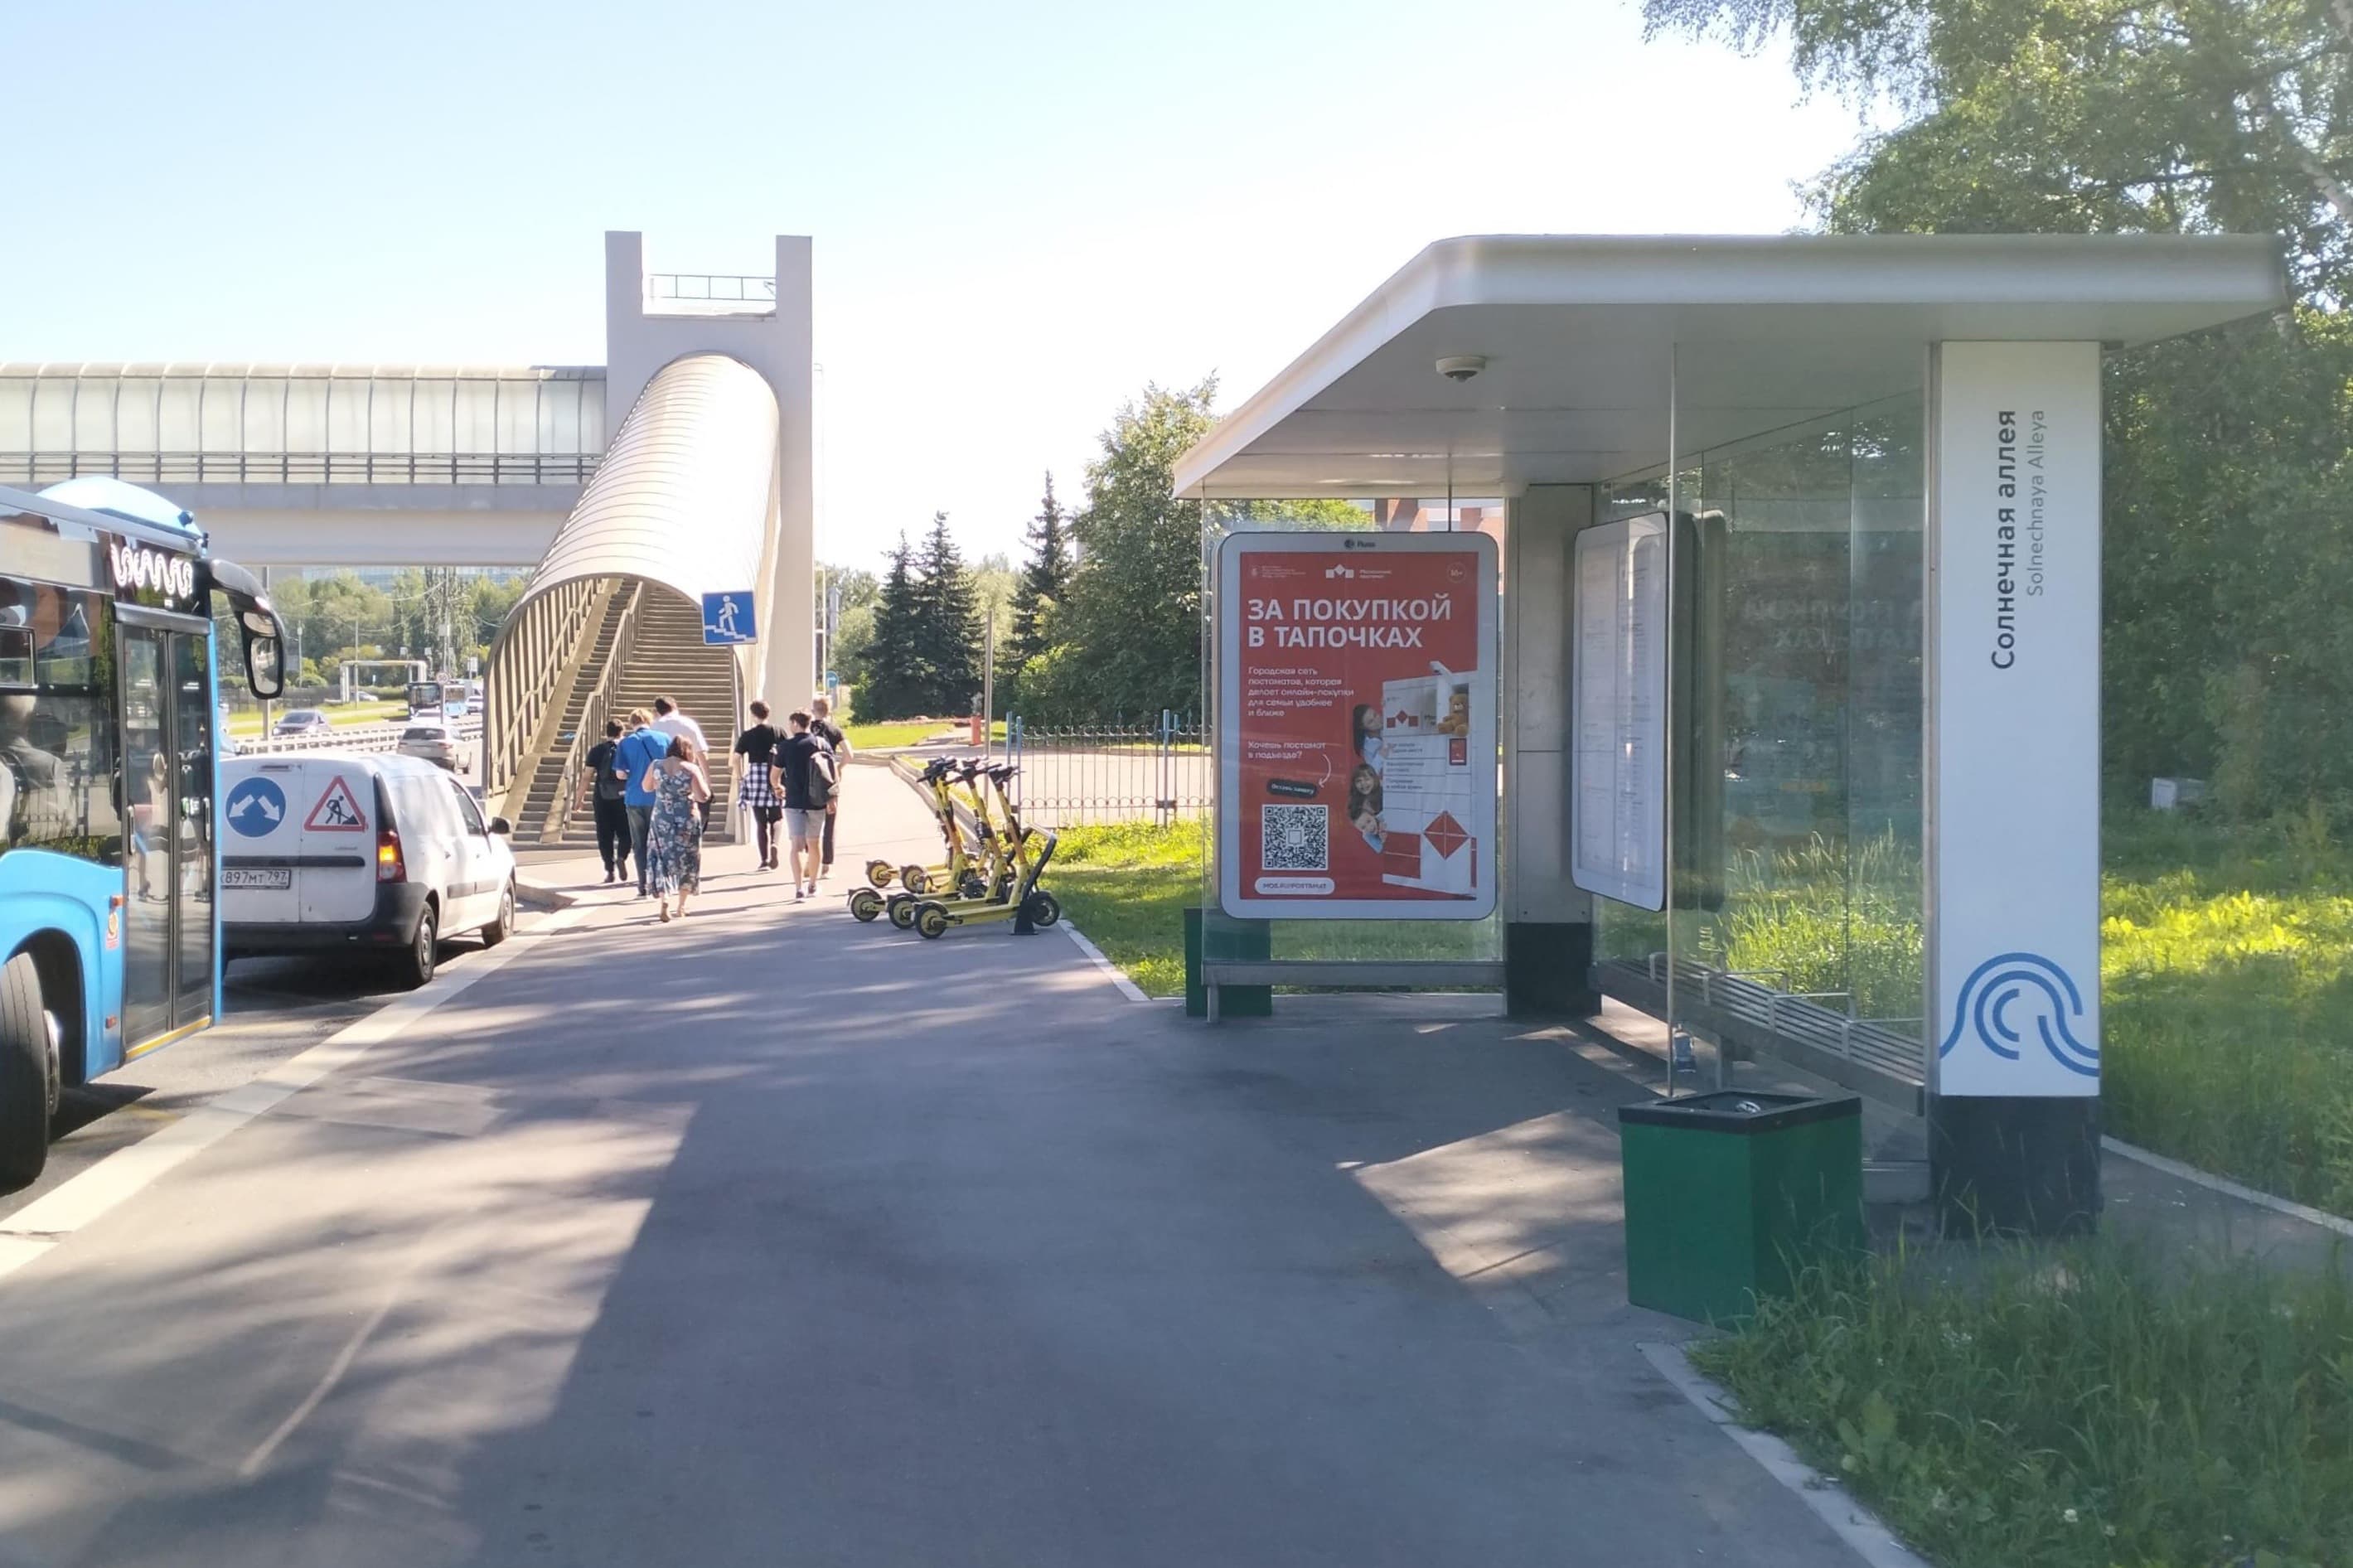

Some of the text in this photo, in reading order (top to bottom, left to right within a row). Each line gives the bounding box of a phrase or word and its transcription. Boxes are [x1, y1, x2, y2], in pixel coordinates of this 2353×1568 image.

[2026, 410, 2047, 597] Solnechnaya Alleya
[1991, 410, 2016, 670] Солнечная аллея
[1247, 593, 1451, 621] ЗА ПОКУПКОЙ
[1247, 627, 1423, 648] В ТАПОЧКАХ
[1247, 666, 1296, 675] Городская
[1305, 679, 1343, 687] которая
[1247, 699, 1264, 708] для
